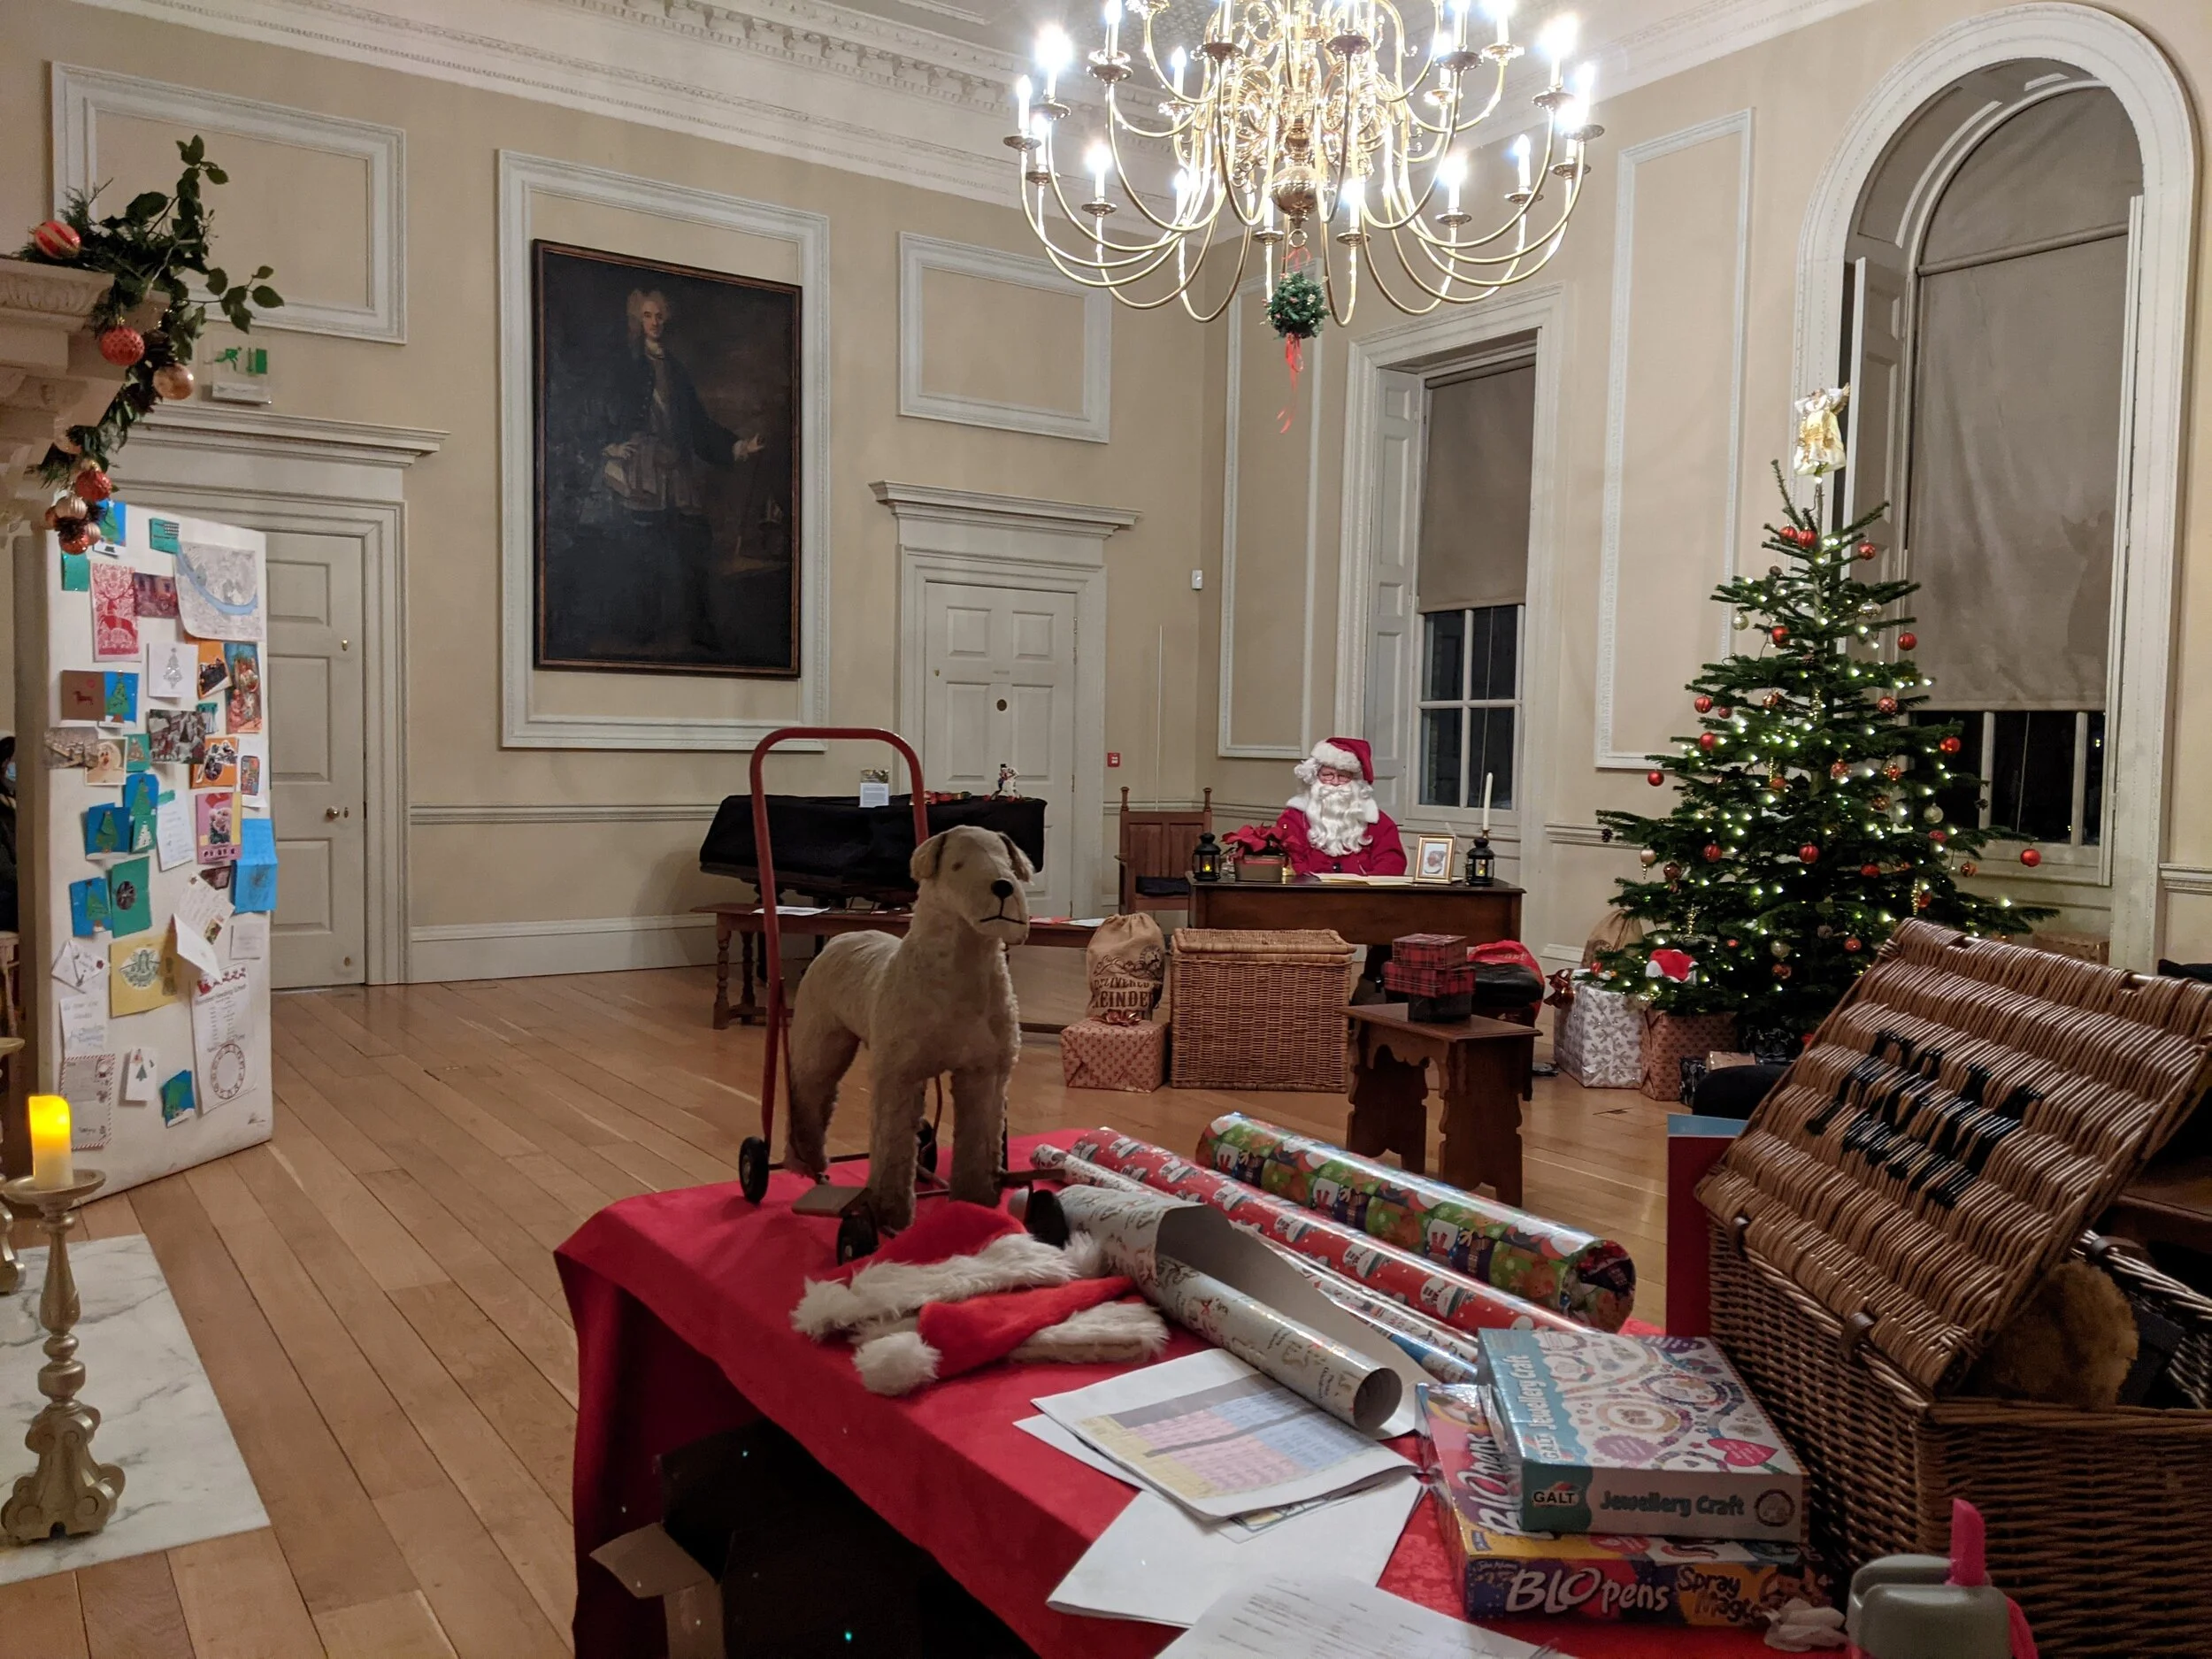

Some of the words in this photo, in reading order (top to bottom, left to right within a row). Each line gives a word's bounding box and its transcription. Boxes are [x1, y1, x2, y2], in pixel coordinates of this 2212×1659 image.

[1502, 1355, 1537, 1379] Craft
[1517, 1379, 1557, 1430] Jewellery
[1533, 1491, 1575, 1505] GALT
[1600, 1491, 1692, 1517] Jewellery
[1696, 1494, 1745, 1516] Craft
[1678, 1565, 1741, 1599] Spray
